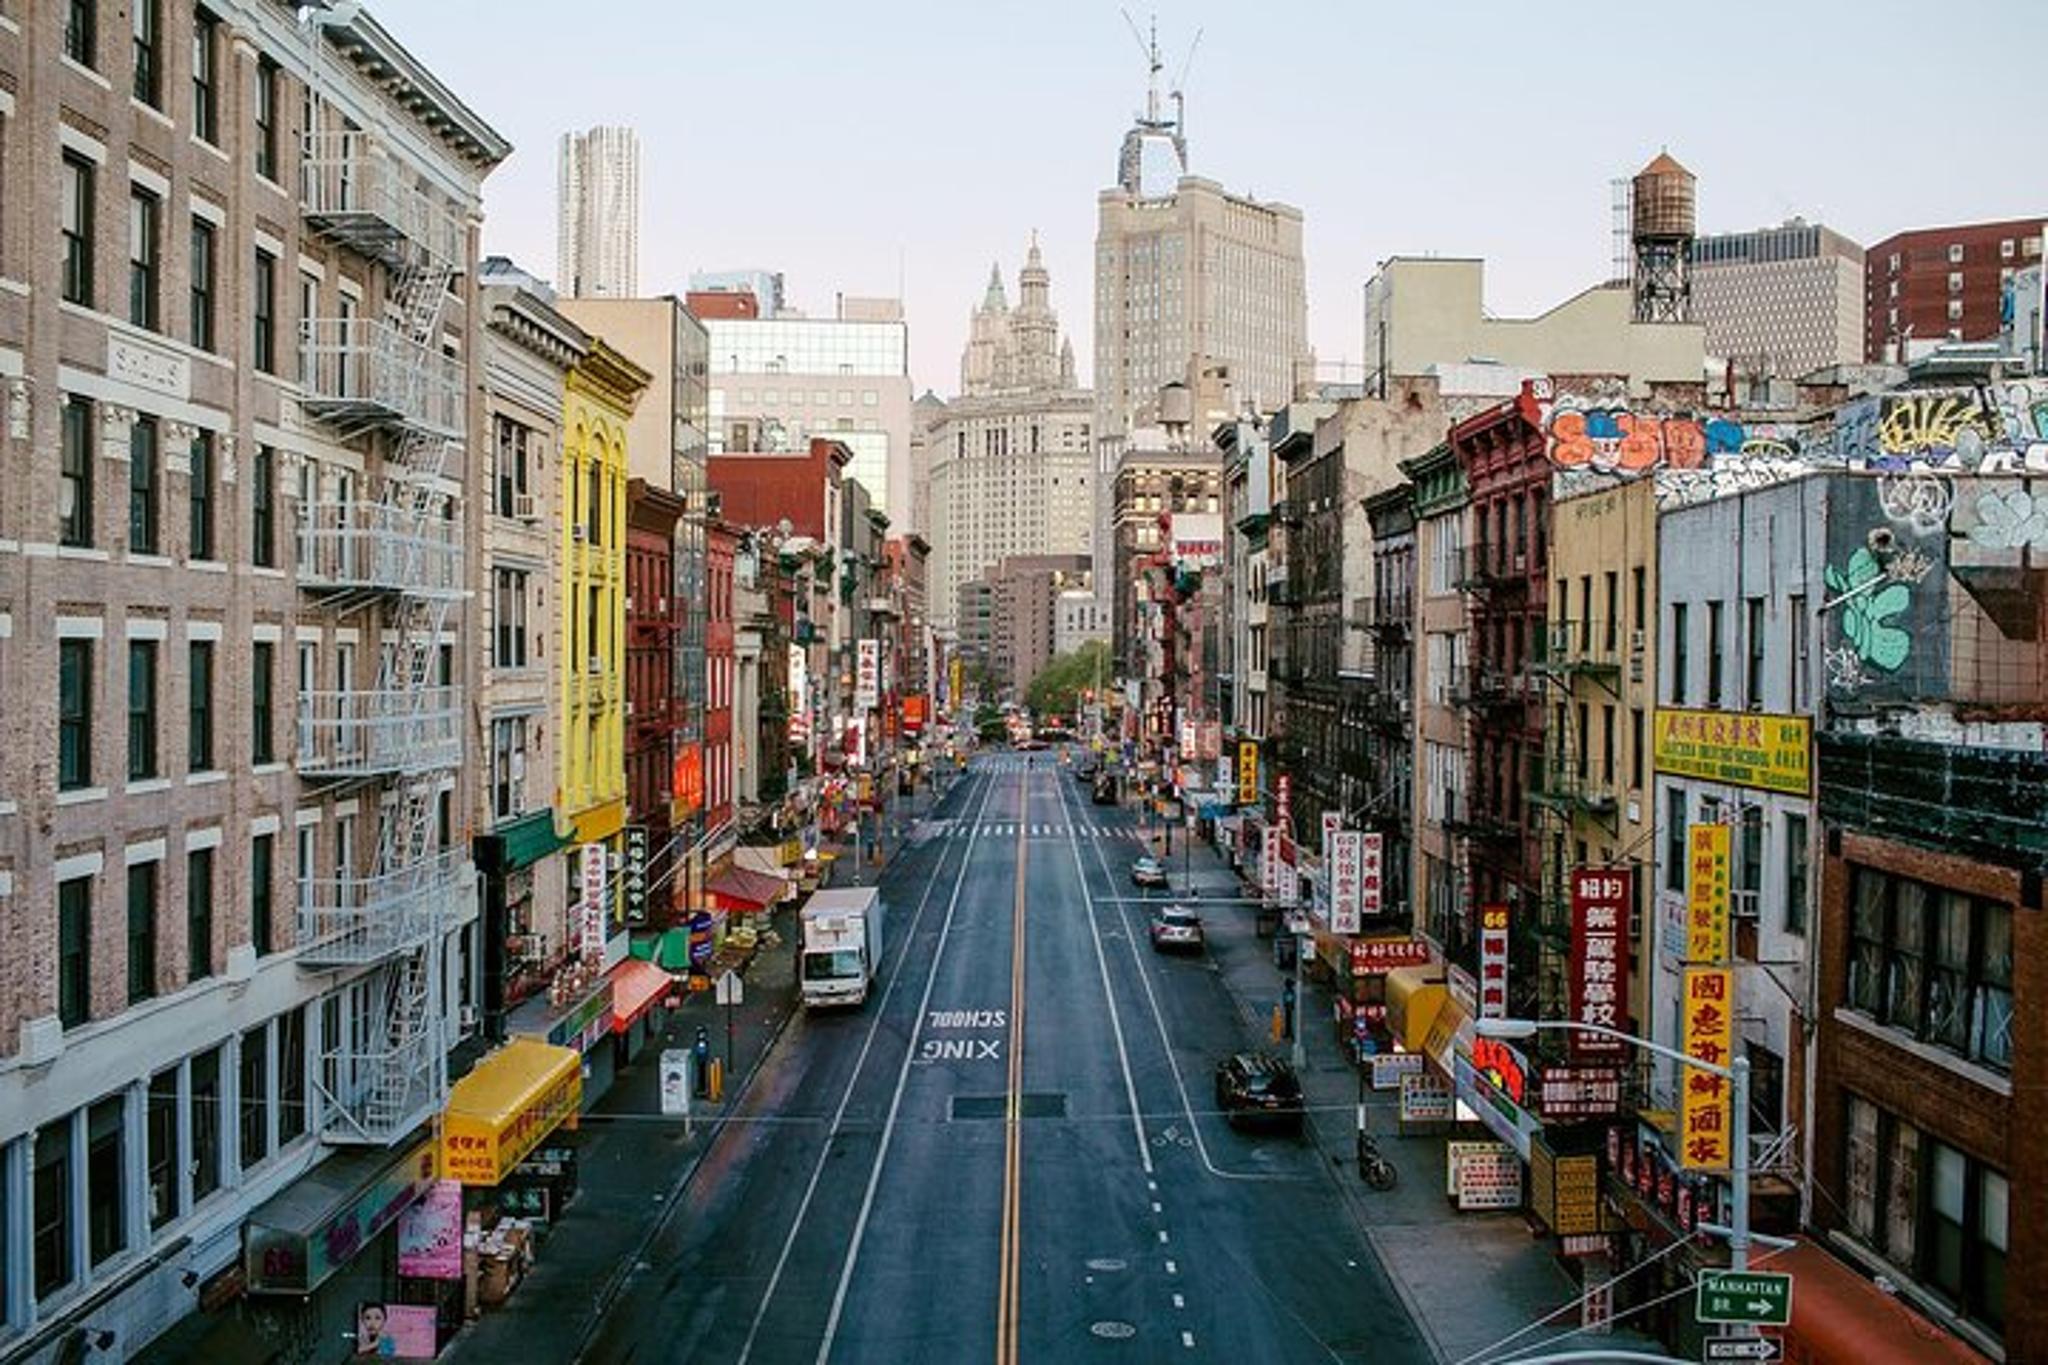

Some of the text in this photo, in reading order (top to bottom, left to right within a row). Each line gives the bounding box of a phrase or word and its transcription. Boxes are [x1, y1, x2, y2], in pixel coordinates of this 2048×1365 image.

[1484, 911, 1508, 928] 66
[929, 1010, 1006, 1028] SCHOOL
[922, 1040, 1000, 1059] XING
[1708, 1279, 1783, 1294] MANHATTAN
[1712, 1297, 1731, 1312] BR
